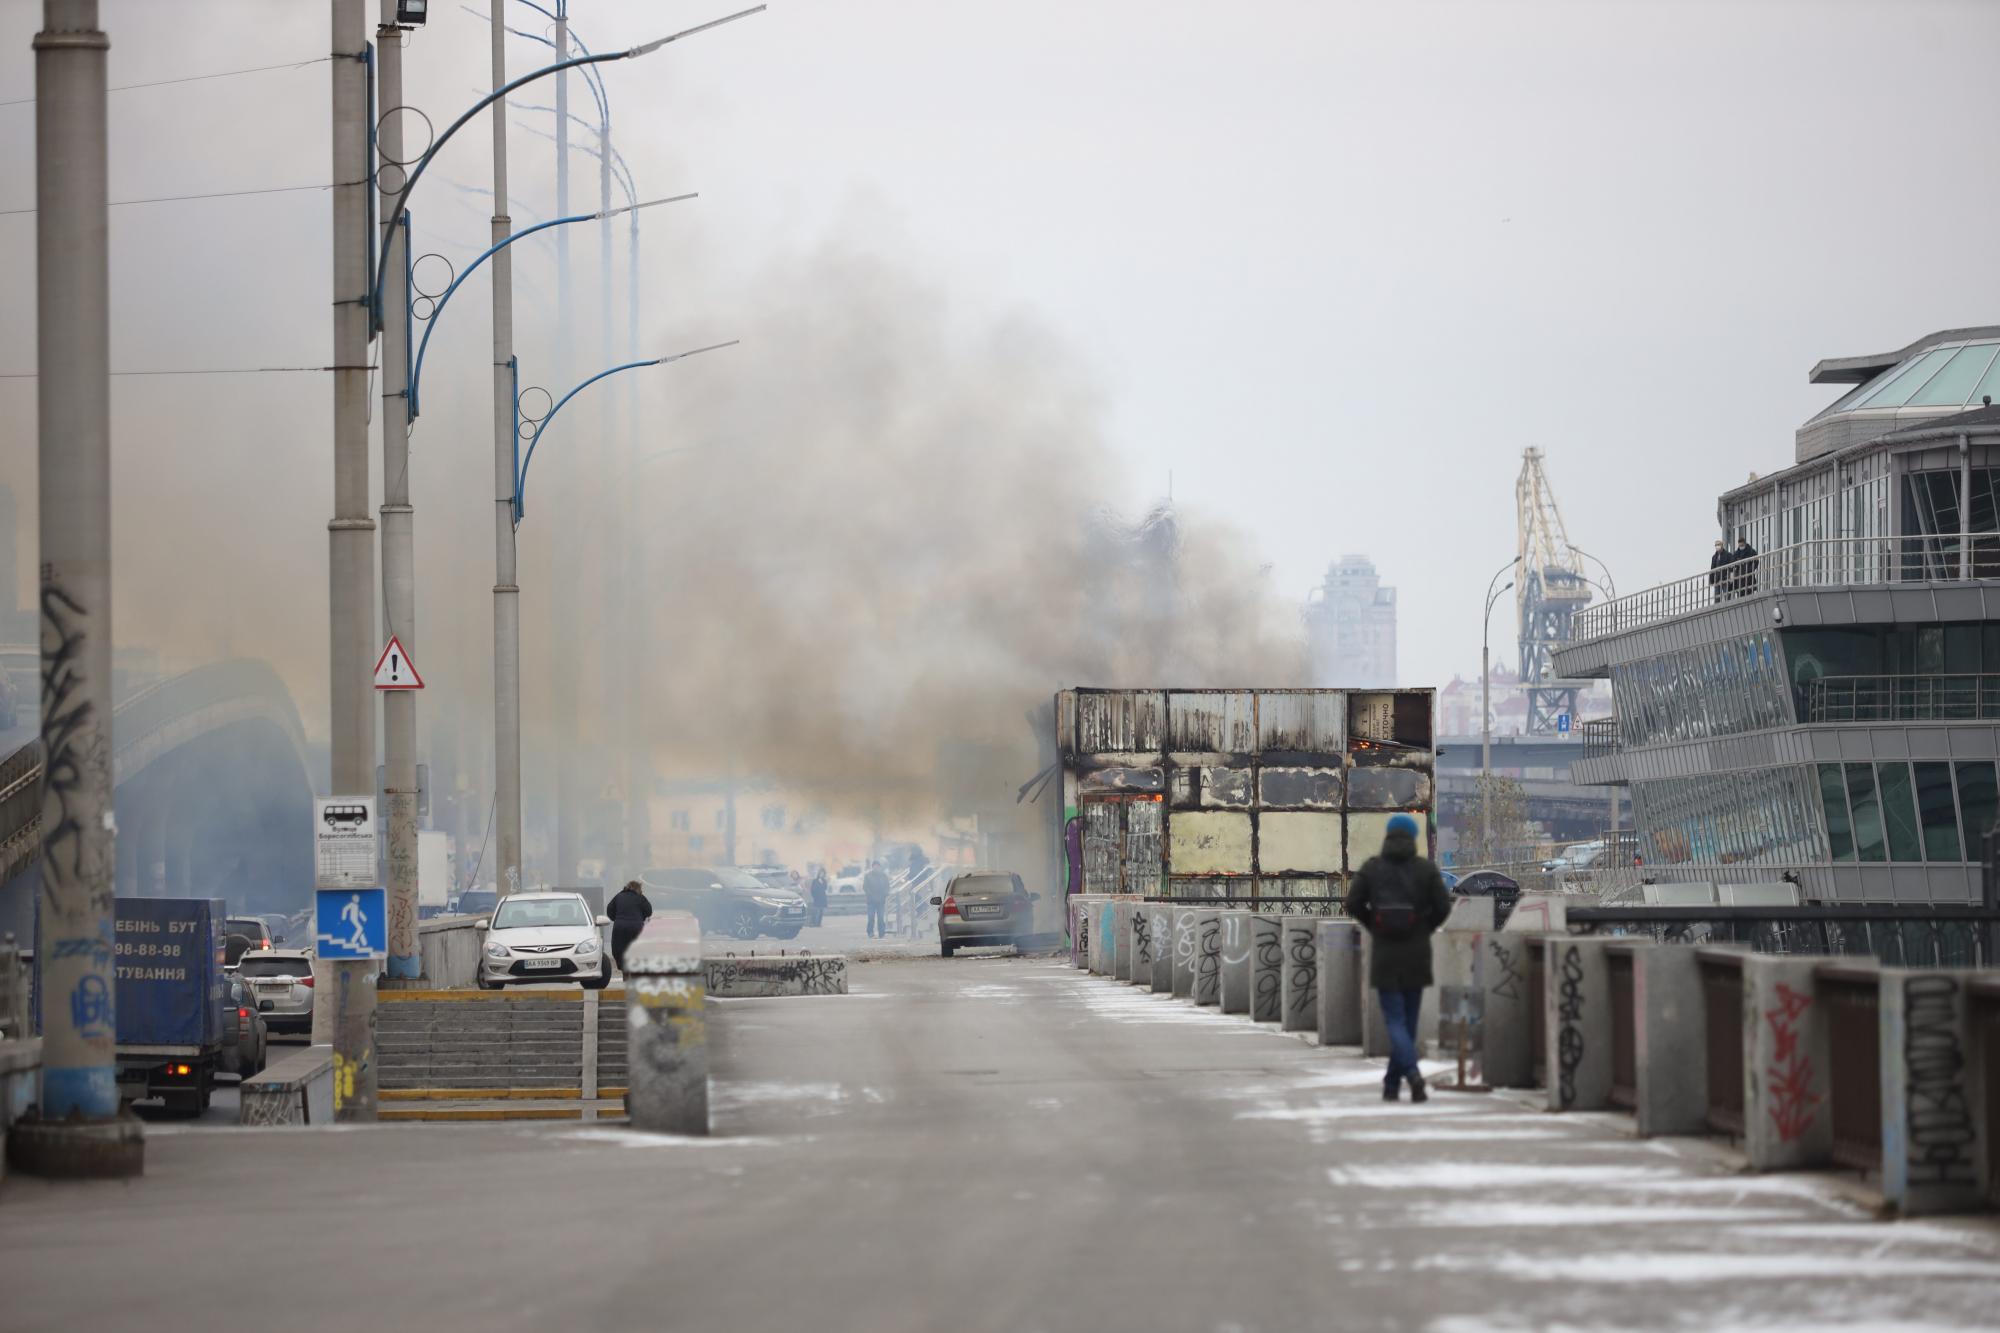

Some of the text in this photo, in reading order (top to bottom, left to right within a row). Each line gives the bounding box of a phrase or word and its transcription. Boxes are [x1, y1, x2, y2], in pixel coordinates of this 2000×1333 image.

[115, 920, 197, 933] ЕБІНЬ БУТ
[115, 943, 181, 957] 98-88-98
[114, 967, 186, 980] ТУВАННЯ
